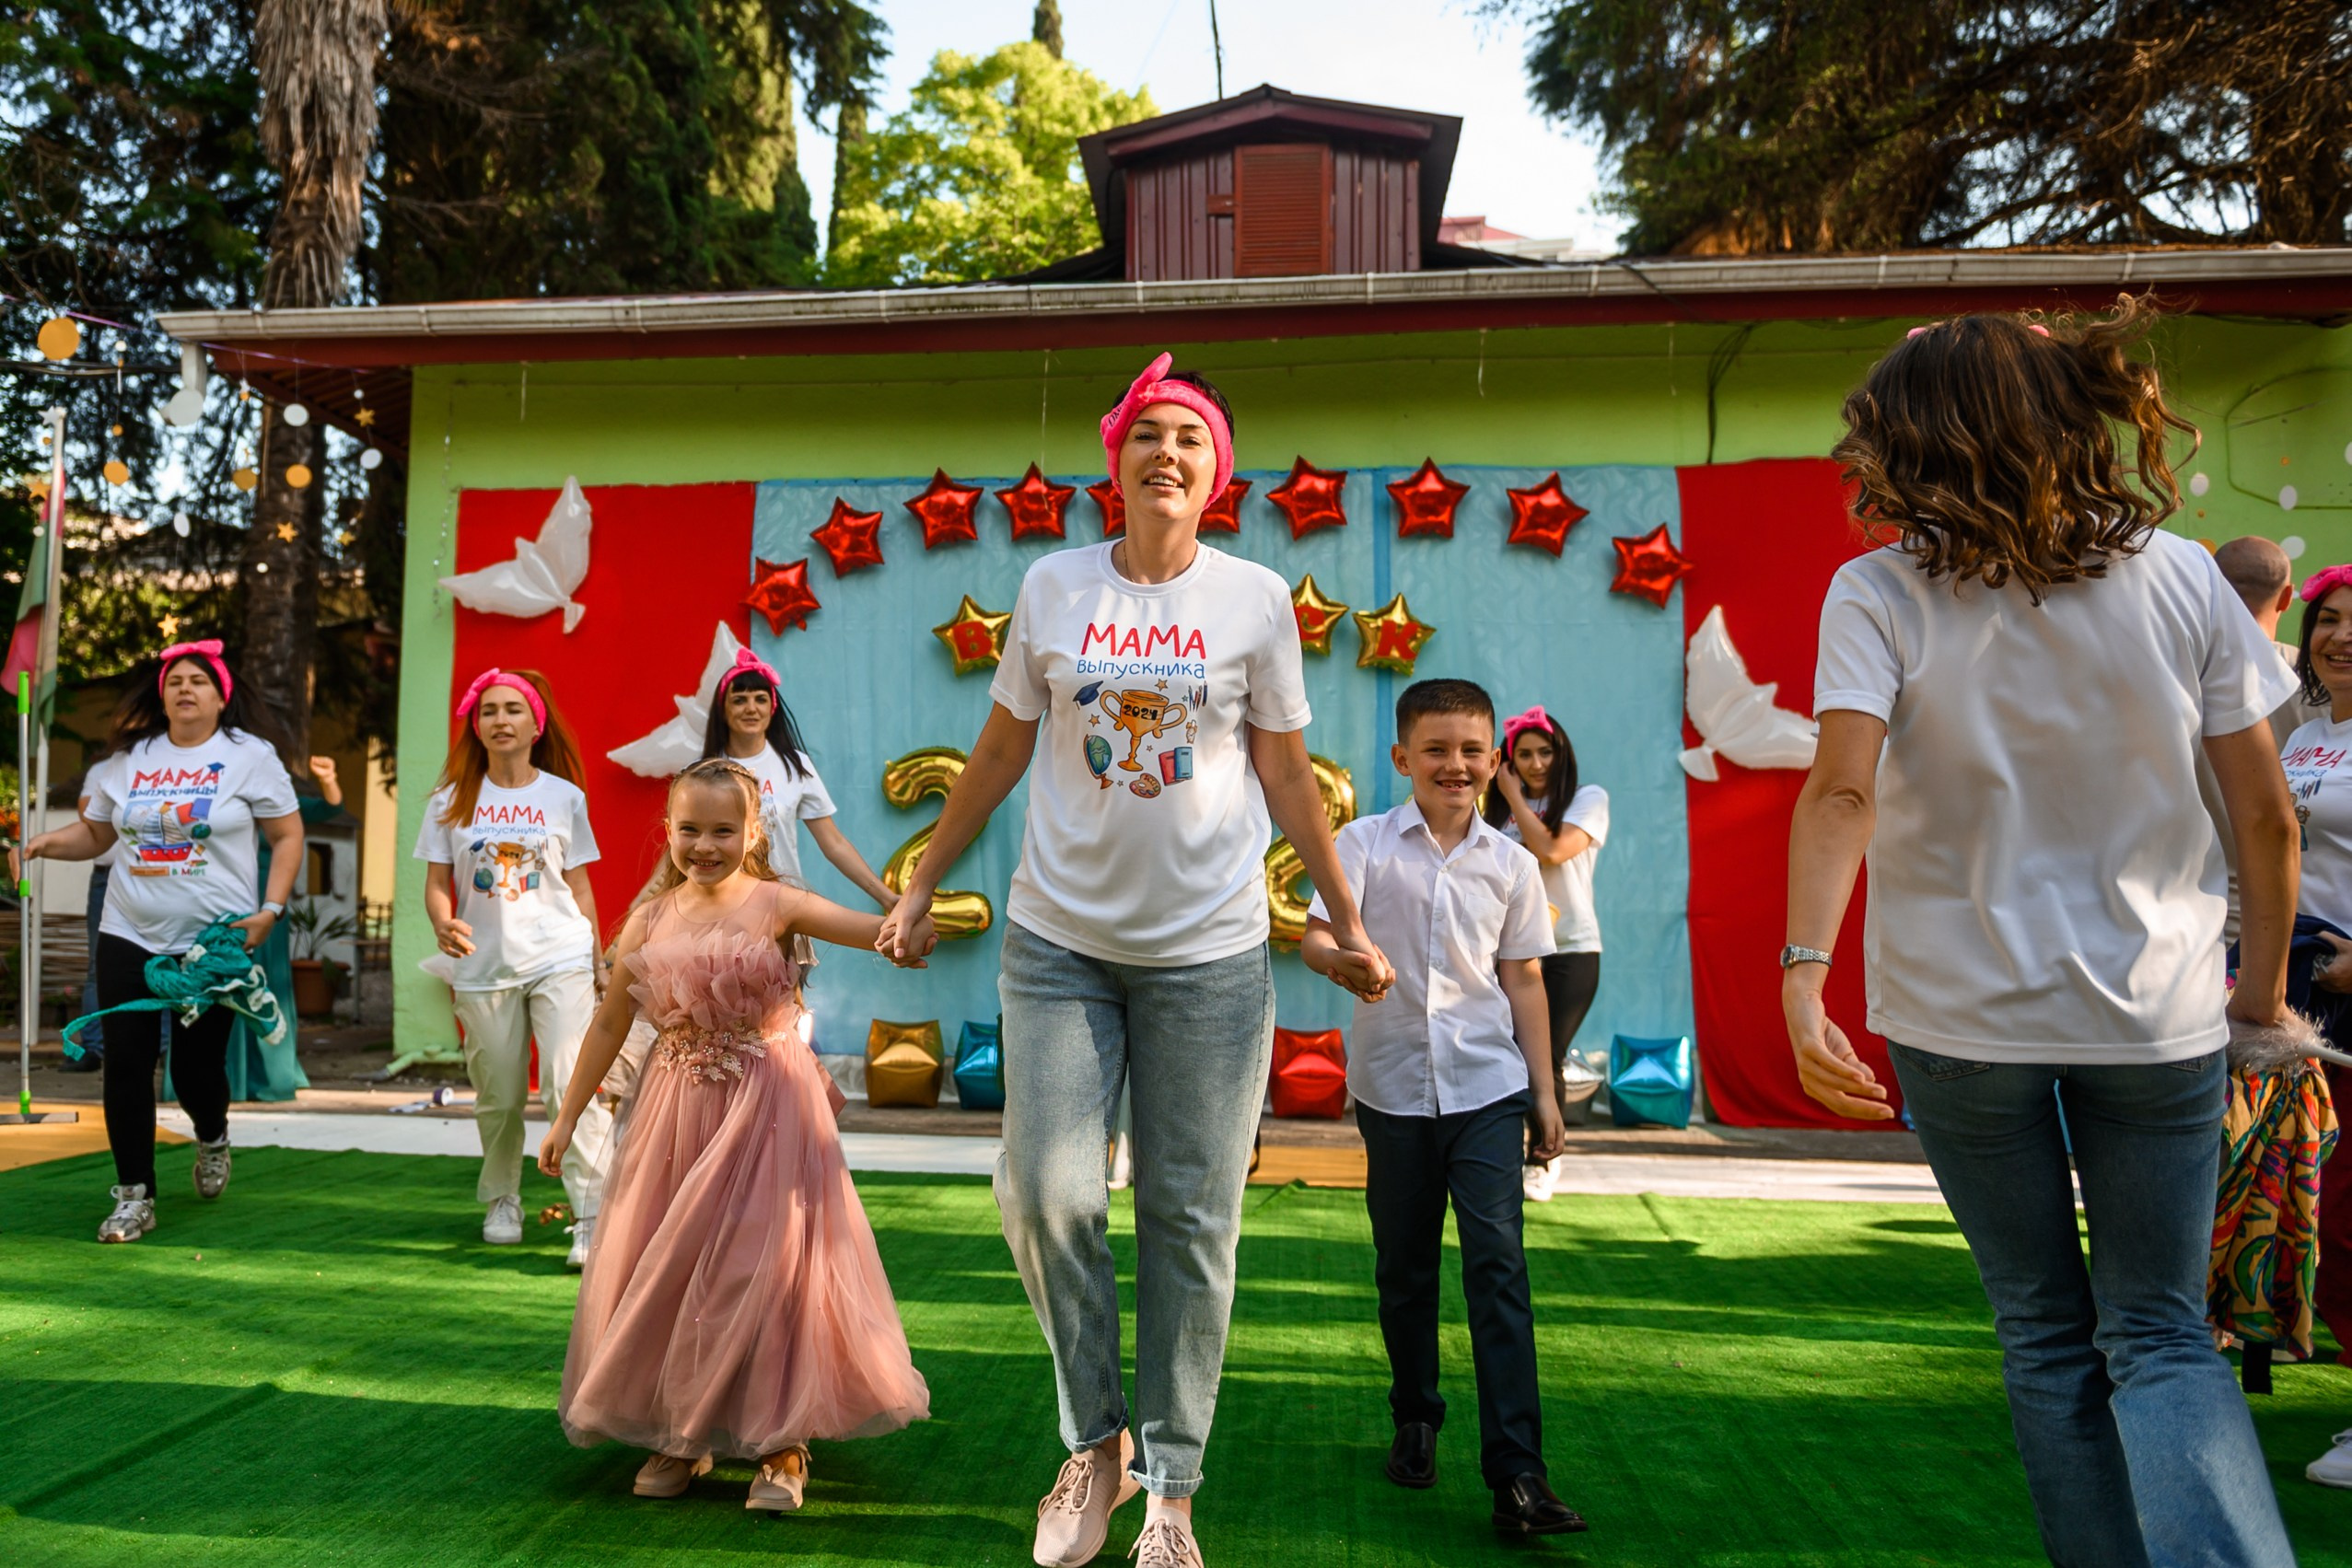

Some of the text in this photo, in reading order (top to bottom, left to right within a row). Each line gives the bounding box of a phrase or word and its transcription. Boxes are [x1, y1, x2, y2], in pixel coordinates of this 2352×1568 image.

[1080, 622, 1206, 659] МАМА
[1123, 704, 1159, 720] 2024
[132, 767, 219, 789] МАМА
[474, 805, 545, 827] МАМА
